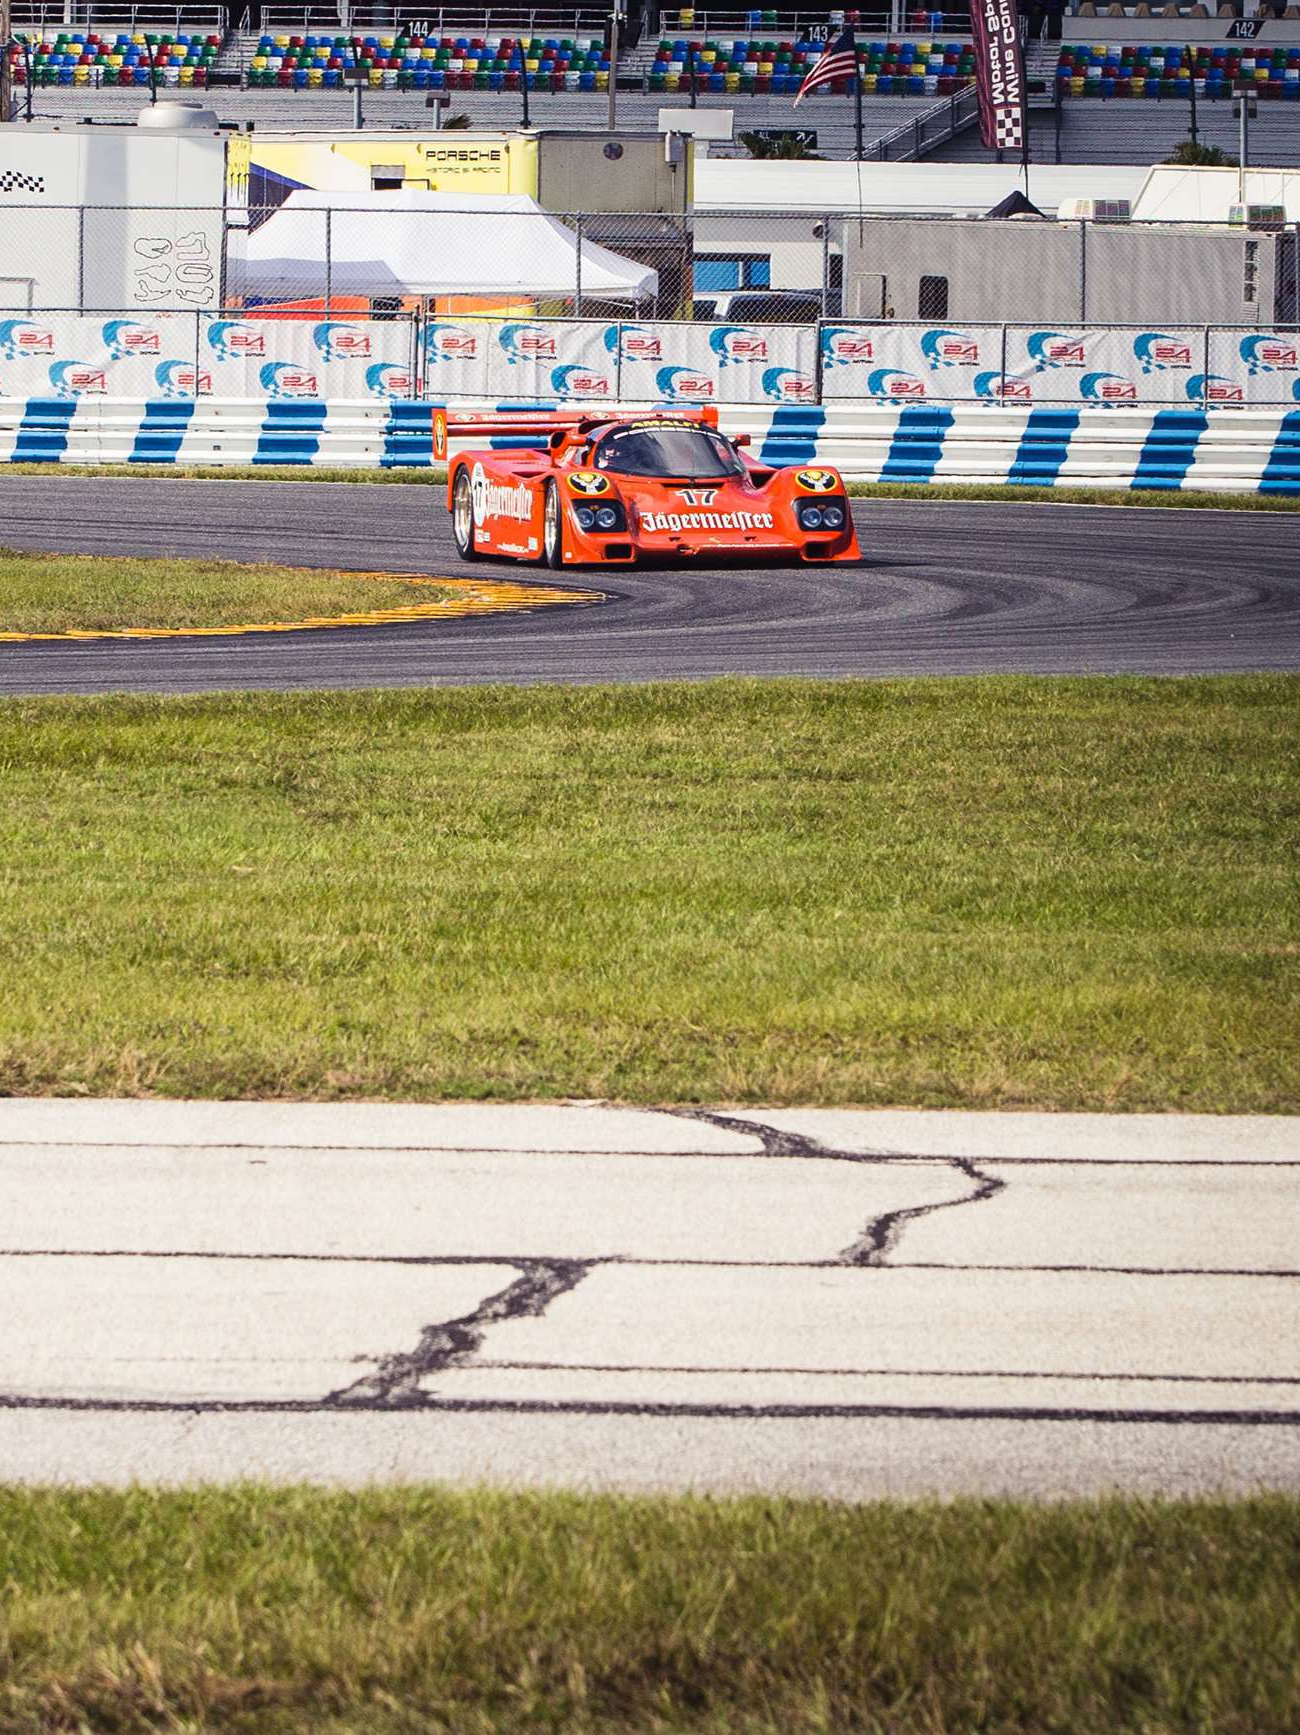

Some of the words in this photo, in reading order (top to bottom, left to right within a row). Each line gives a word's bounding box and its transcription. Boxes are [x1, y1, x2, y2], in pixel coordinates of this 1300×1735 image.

[408, 22, 429, 36] 144
[808, 26, 829, 42] 143
[1235, 22, 1255, 38] 142
[426, 150, 501, 161] PORSCHE
[19, 333, 55, 350] 24
[124, 334, 161, 350] 24
[230, 335, 266, 352] 24
[336, 336, 372, 353] 24
[441, 338, 477, 353] 24
[521, 338, 557, 354] 24
[626, 339, 662, 355] 24
[732, 341, 768, 357] 24
[838, 342, 874, 358] 24
[943, 343, 980, 361] 24
[1049, 345, 1085, 361] 24
[1155, 347, 1192, 363] 24
[1262, 349, 1298, 365] 24
[675, 488, 718, 506] 17
